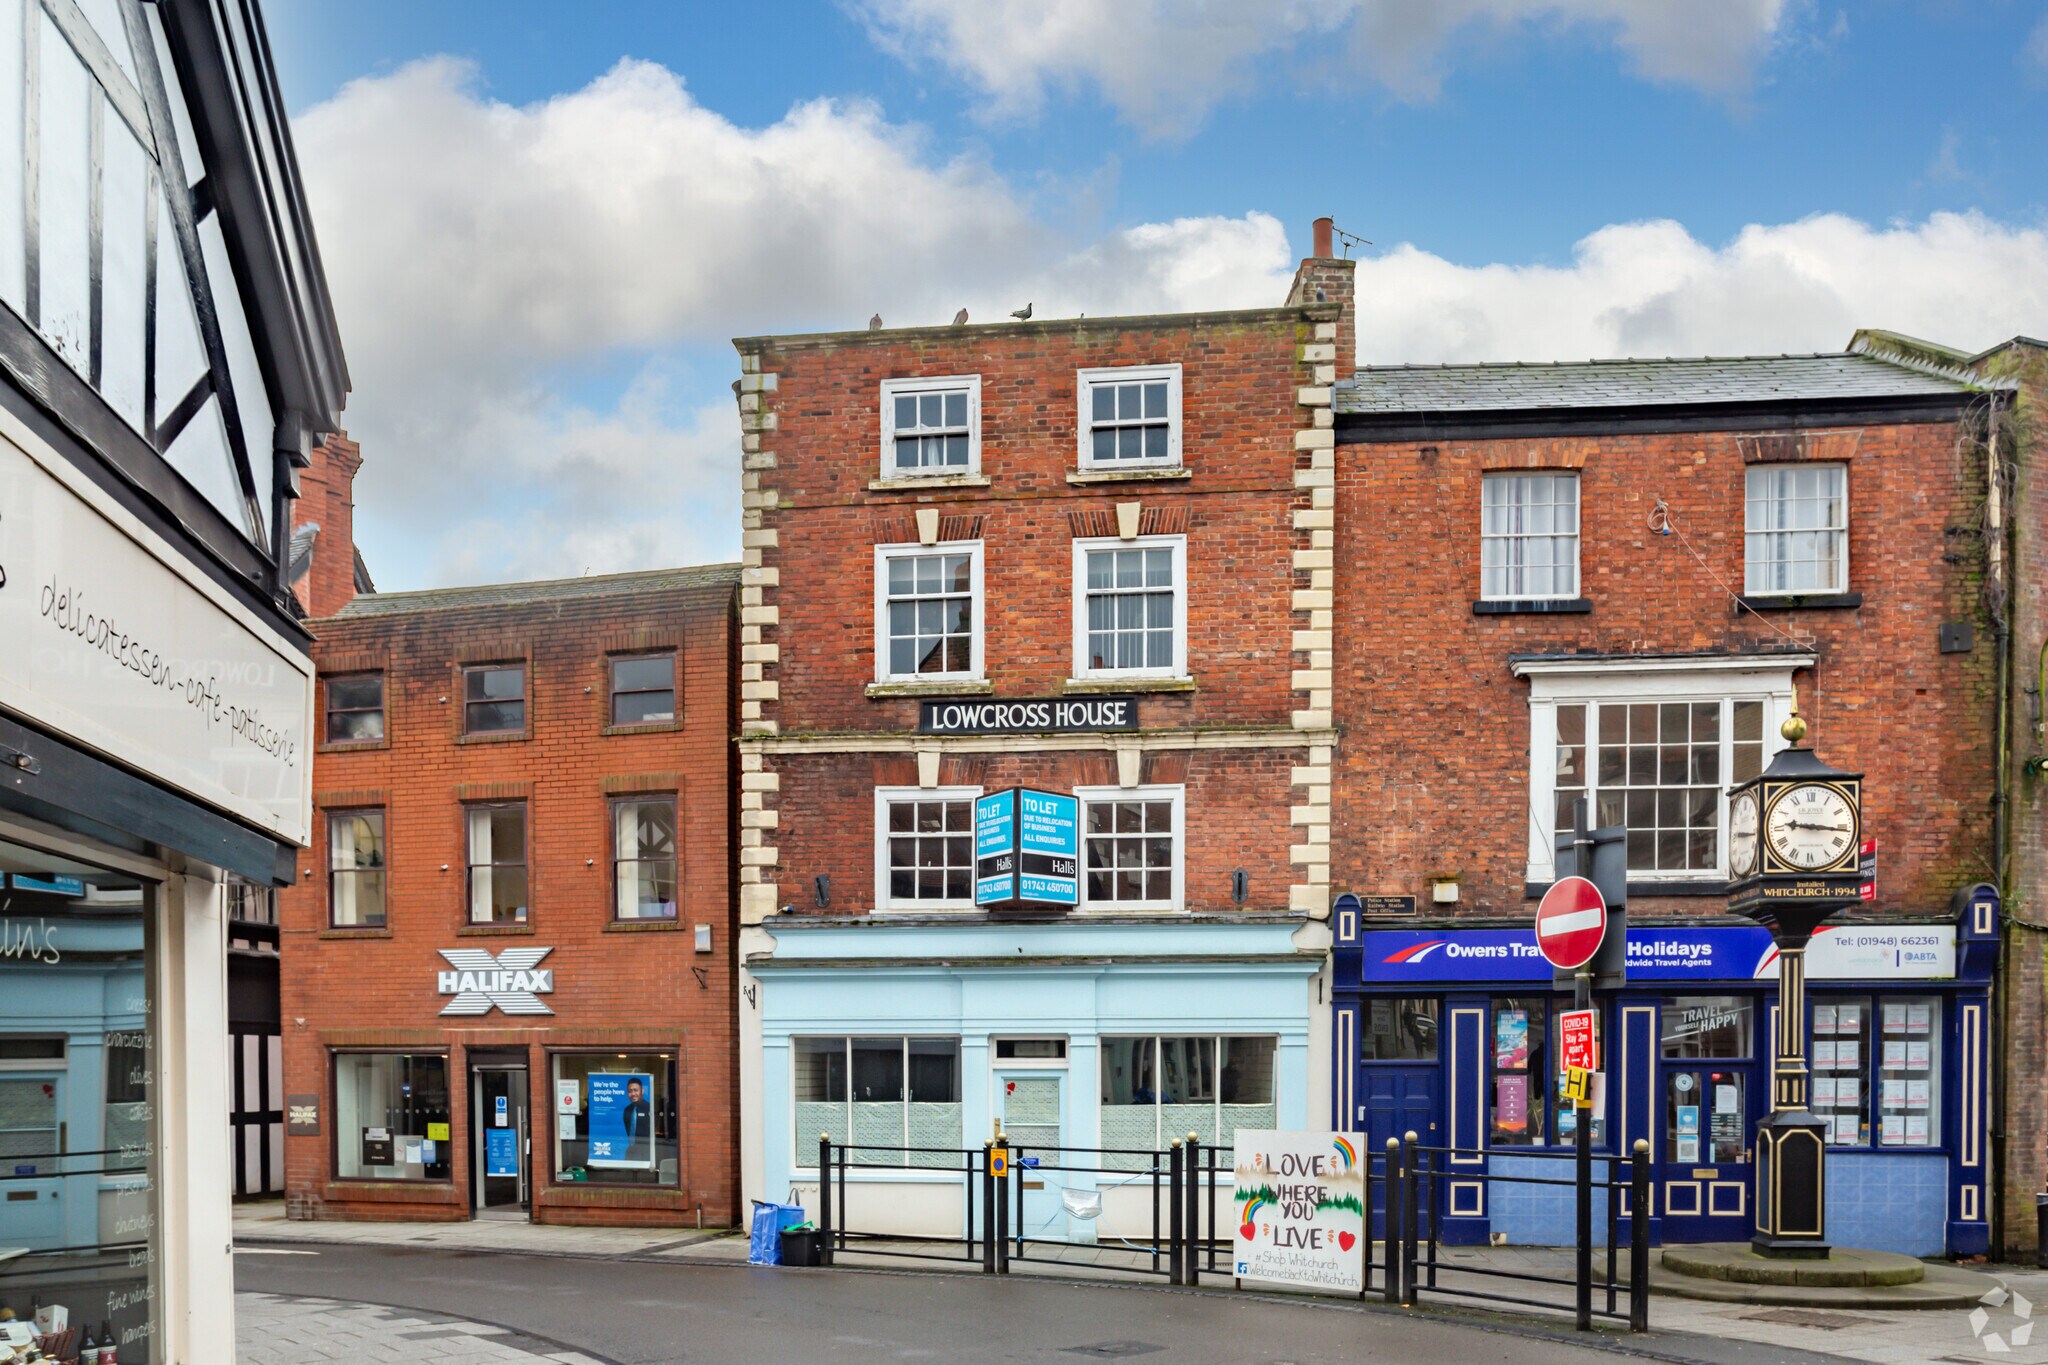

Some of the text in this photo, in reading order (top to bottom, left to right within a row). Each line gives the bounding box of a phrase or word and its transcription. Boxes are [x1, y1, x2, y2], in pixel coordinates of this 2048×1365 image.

[932, 701, 1127, 729] LOWCROSS HOUSE
[979, 804, 1001, 819] TO LET
[1024, 798, 1058, 815] TO LET
[1024, 814, 1035, 822] DUE
[1043, 817, 1073, 827] RELOCATION
[1031, 824, 1057, 833] BUSINESS
[1024, 834, 1066, 846] ALL ENQUIRIES
[1052, 859, 1075, 874] Halls
[1022, 880, 1074, 894] 01743 450700
[1764, 888, 1830, 897] WHITCHURCH
[1834, 887, 1857, 896] 1994
[1835, 936, 1939, 947] Tel: (01948) 662361
[1446, 943, 1508, 957] Owen's
[1627, 941, 1712, 959] Holidays
[1913, 952, 1937, 961] ABTA
[1654, 958, 1680, 967] Travel
[1681, 958, 1712, 968] Agents
[439, 970, 552, 993] HALIFAX
[1681, 1005, 1723, 1023] TRAVEL
[1563, 1017, 1589, 1029] COVID-19
[1701, 1012, 1738, 1032] HAPPY
[1565, 1032, 1588, 1044] Stay 2m
[1568, 1044, 1584, 1054] apart
[1567, 1069, 1583, 1097] H
[289, 1110, 317, 1119] HALIFAX
[1265, 1153, 1327, 1178] LOVE
[1267, 1183, 1328, 1206] WHERE
[1281, 1201, 1314, 1221] YOU
[1273, 1225, 1323, 1250] LIVE
[1288, 1252, 1339, 1270] Whitchurch
